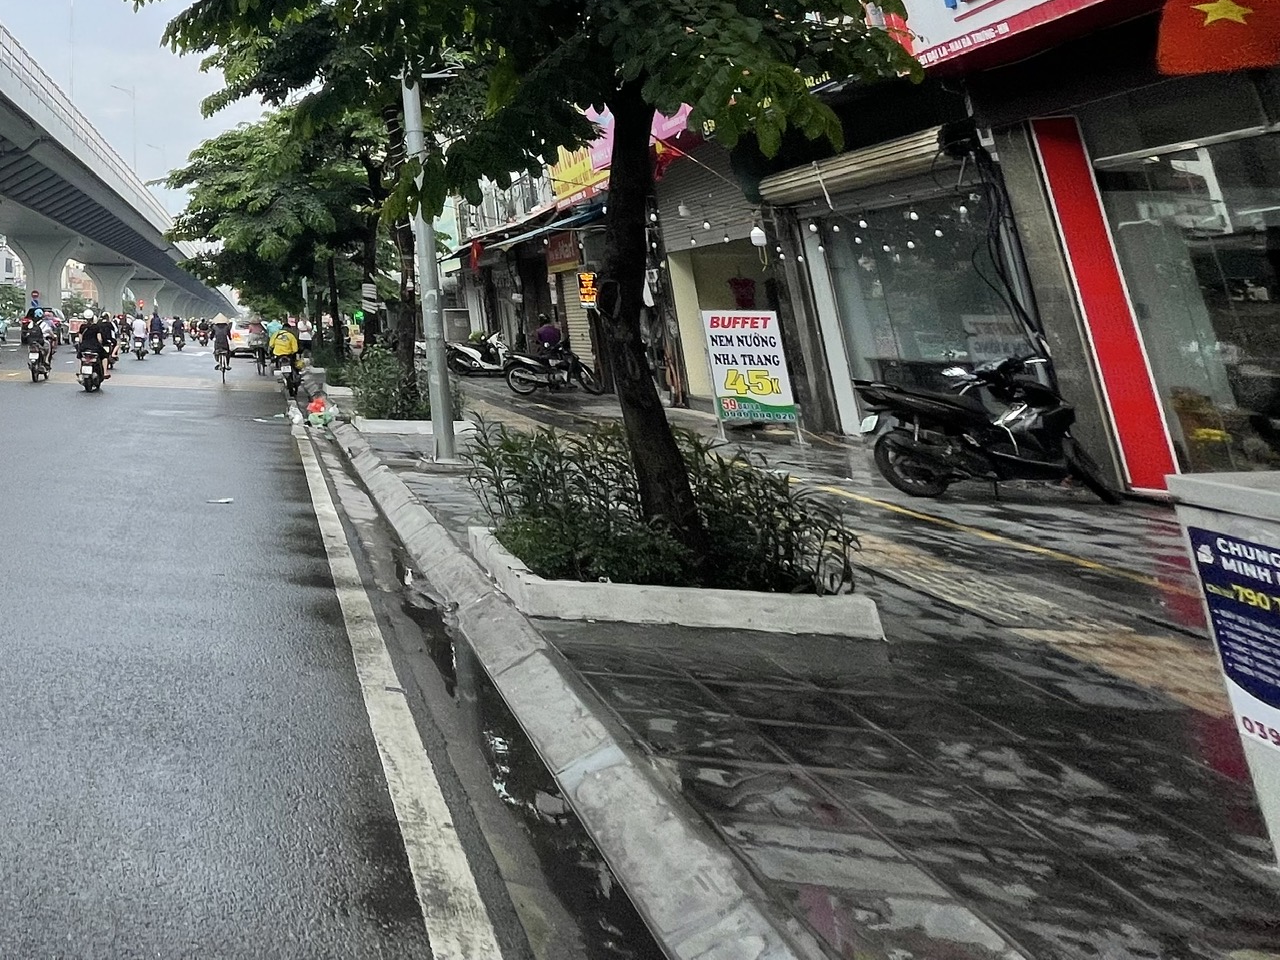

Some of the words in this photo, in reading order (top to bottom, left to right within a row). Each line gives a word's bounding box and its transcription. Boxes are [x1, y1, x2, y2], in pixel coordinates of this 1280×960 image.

[709, 316, 771, 329] BUFFET
[709, 334, 734, 347] NEM
[713, 353, 739, 365] NHA
[740, 354, 780, 367] TRANG
[721, 398, 737, 411] 59
[1219, 555, 1273, 584] MINH
[1231, 582, 1271, 611] 790
